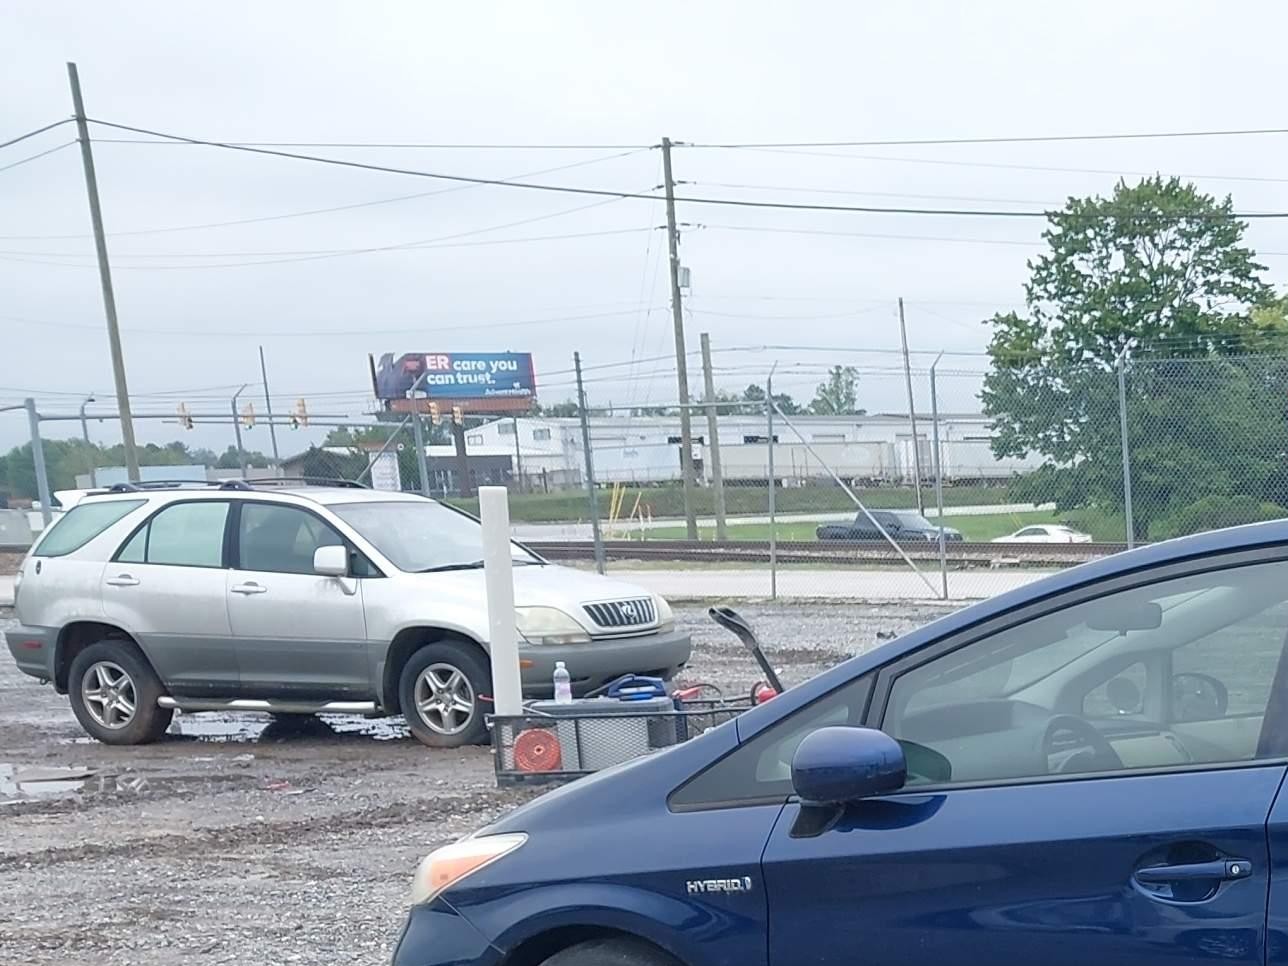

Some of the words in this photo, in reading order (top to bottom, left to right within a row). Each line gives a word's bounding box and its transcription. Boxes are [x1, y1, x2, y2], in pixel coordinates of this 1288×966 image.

[425, 355, 449, 370] ER
[453, 359, 486, 371] care
[490, 359, 517, 373] you
[427, 373, 454, 385] can
[456, 372, 496, 385] trust.
[686, 878, 741, 893] HYBRID
